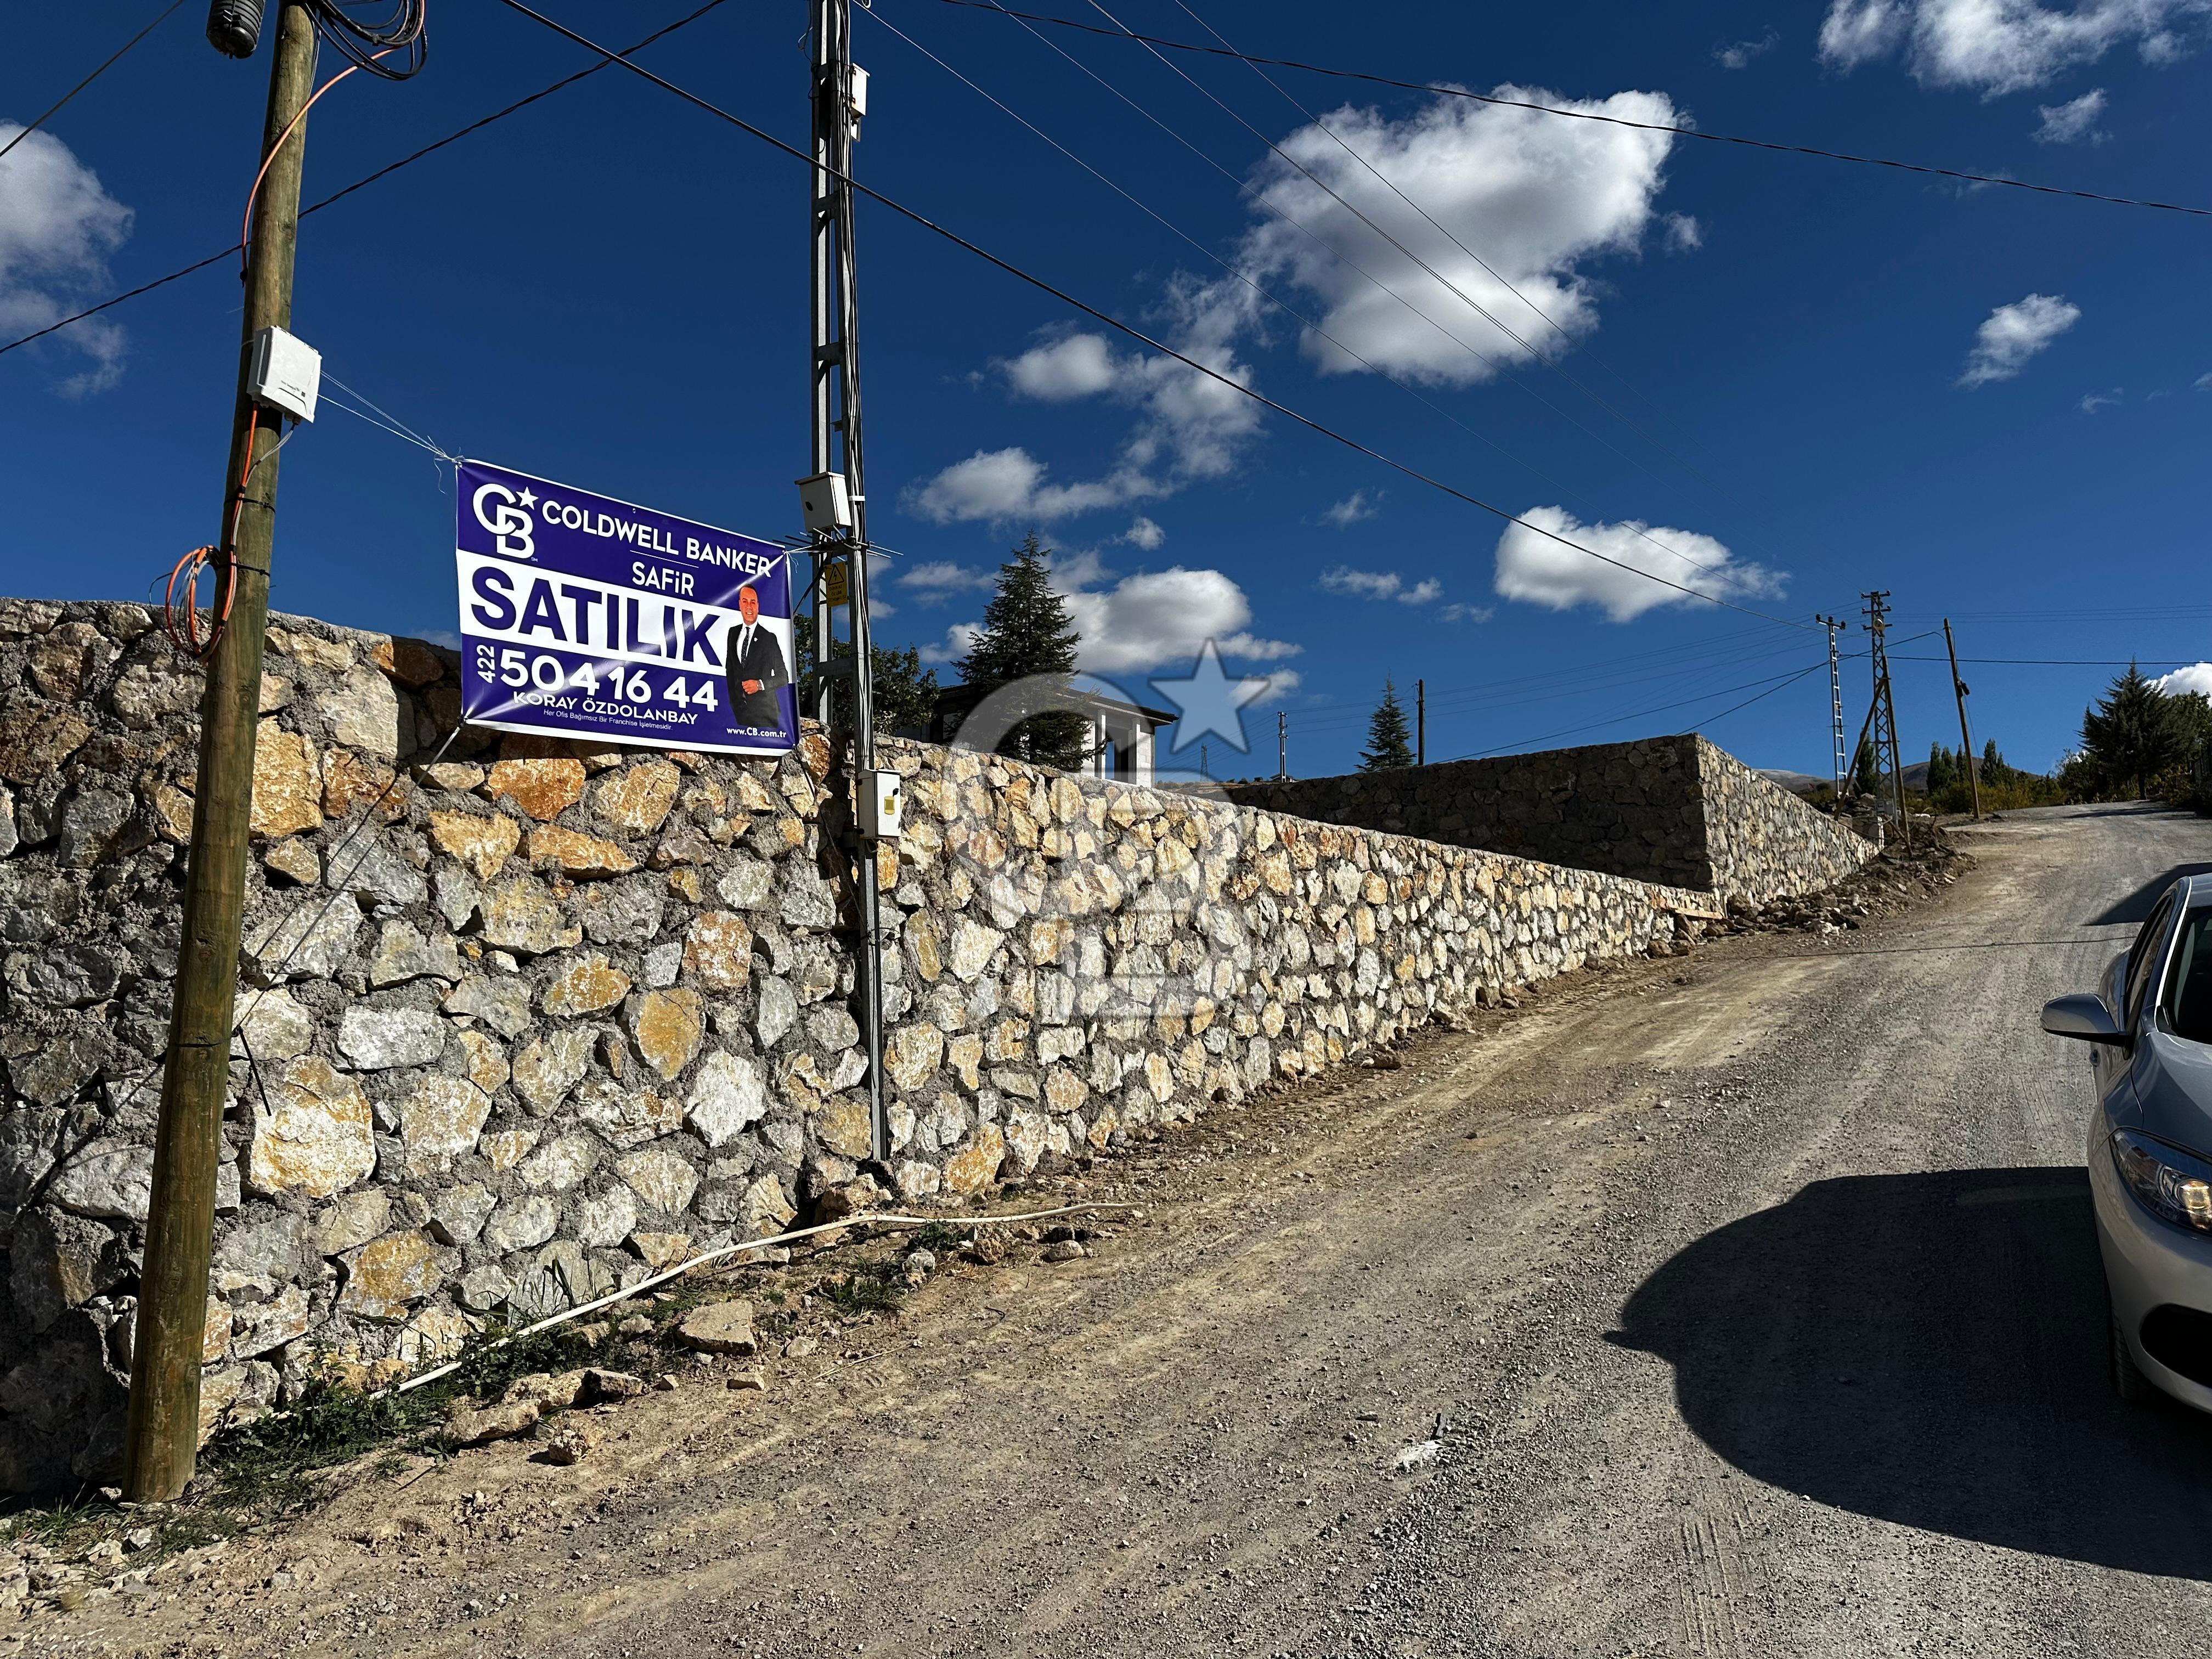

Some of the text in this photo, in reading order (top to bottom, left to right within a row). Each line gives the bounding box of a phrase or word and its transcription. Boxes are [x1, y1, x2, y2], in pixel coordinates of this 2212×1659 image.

[473, 483, 534, 558] CB
[542, 500, 771, 578] COLDWELL BANKER
[470, 566, 723, 667] SATILIK
[476, 645, 496, 684] 422
[500, 648, 719, 712] 504 16 44
[514, 691, 698, 725] KORAY ÖZDOLANBAY
[609, 718, 637, 726] Franchise
[726, 727, 787, 738] www.CB.com.tr
